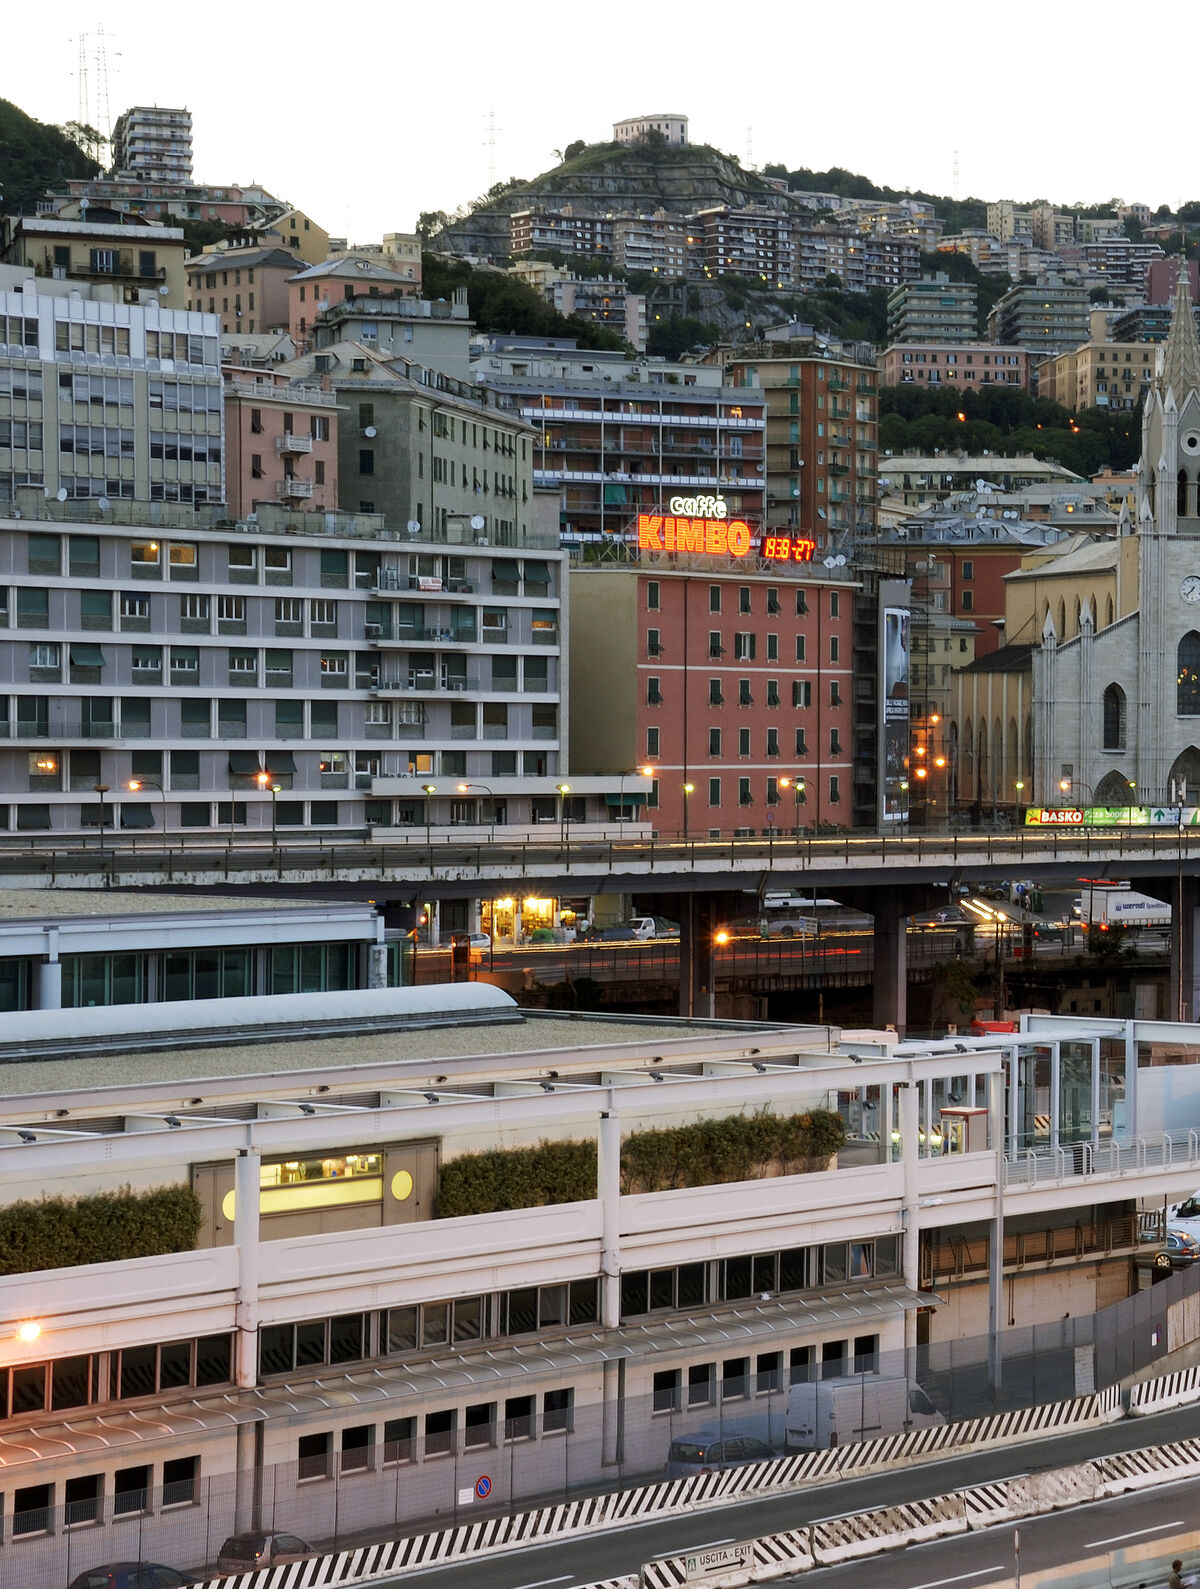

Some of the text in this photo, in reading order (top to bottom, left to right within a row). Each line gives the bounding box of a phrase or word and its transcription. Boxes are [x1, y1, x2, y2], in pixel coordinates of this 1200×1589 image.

[639, 515, 749, 556] KIMBO
[1041, 811, 1082, 823] BASKO
[700, 1551, 728, 1565] USCITA
[734, 1545, 752, 1557] EXIT
